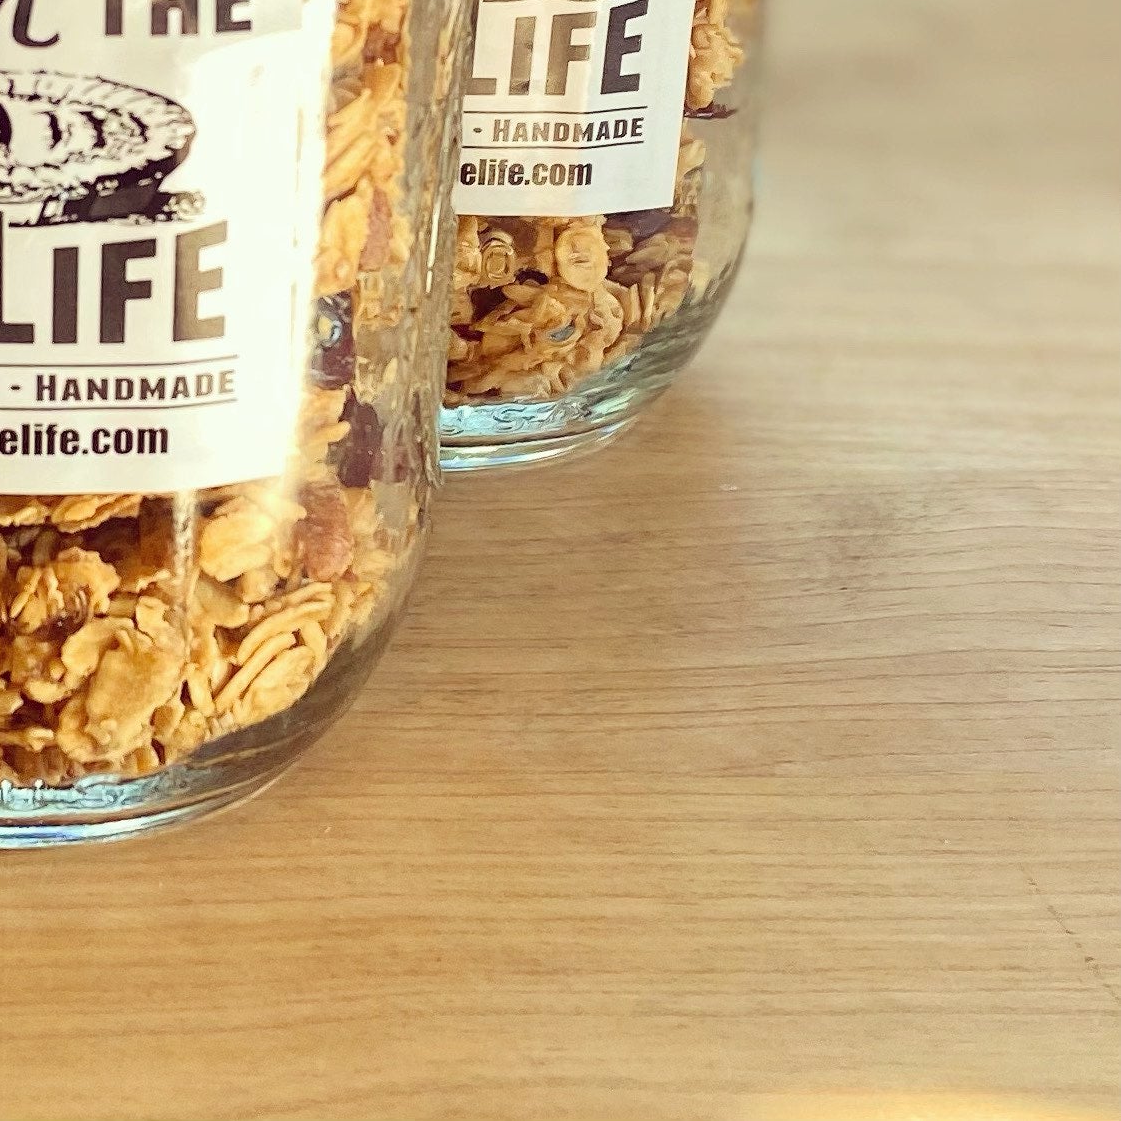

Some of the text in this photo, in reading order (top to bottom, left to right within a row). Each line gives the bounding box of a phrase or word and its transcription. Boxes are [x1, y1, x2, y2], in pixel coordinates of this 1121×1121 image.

[492, 116, 645, 144] HANDMADE
[459, 159, 593, 186] elife.com
[35, 368, 237, 403] HANDMADE
